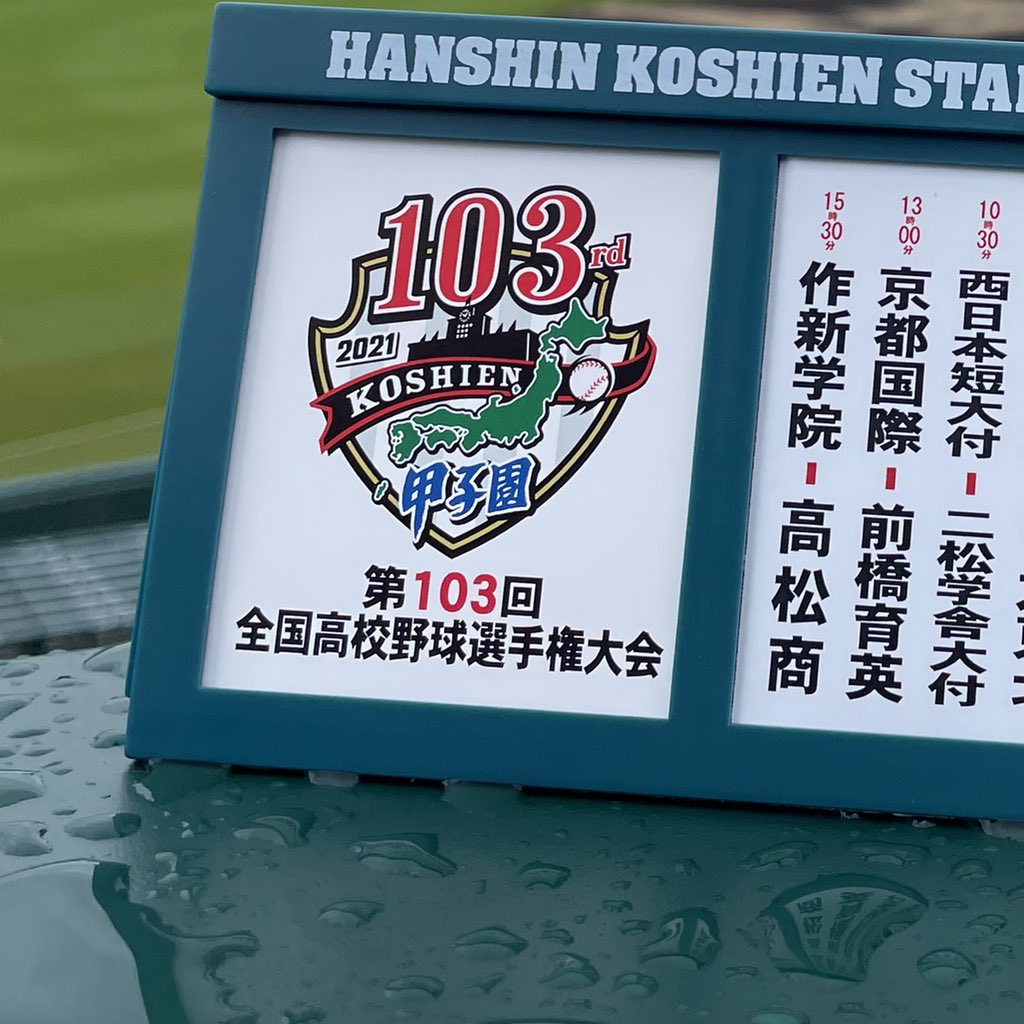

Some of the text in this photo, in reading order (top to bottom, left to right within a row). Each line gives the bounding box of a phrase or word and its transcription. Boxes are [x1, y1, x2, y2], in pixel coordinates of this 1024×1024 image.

[326, 30, 602, 92] HANSHIN
[613, 44, 883, 106] KOSHIEN
[336, 333, 397, 362] 2021
[346, 365, 523, 418] KOSHIEN
[767, 261, 855, 696] 作新学院 高松商
[846, 266, 932, 704] 京都国際 前橋育英
[928, 269, 1011, 707] 西日本短大付 二松学舎大付
[362, 564, 544, 619] 第103回
[235, 606, 664, 678] 全国高校野球選手権大会
